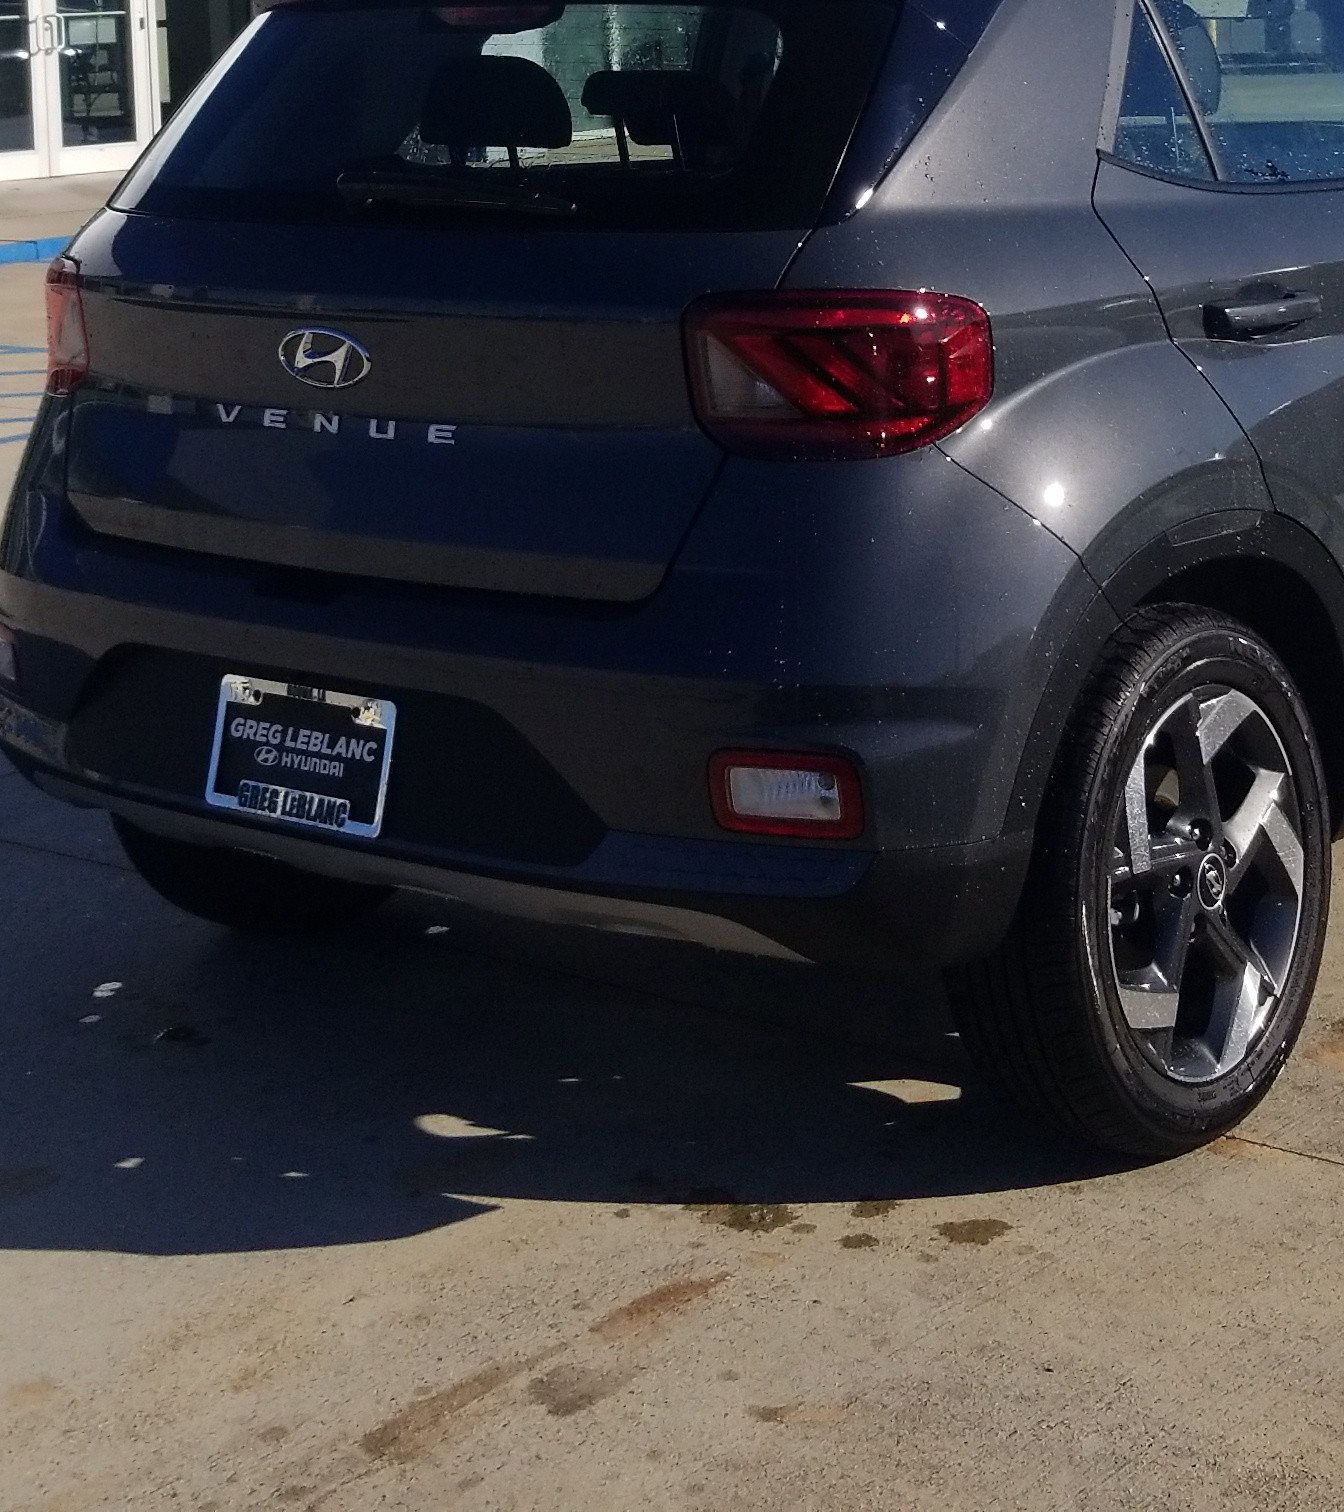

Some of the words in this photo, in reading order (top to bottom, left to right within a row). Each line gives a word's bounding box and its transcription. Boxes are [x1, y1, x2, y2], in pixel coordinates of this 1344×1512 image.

[216, 403, 457, 444] VENUE
[230, 717, 283, 745] GREG
[285, 726, 378, 762] LEBLANC
[281, 752, 345, 778] HYUNDAI
[238, 782, 280, 814] GREG
[280, 790, 348, 828] LEBLANC
